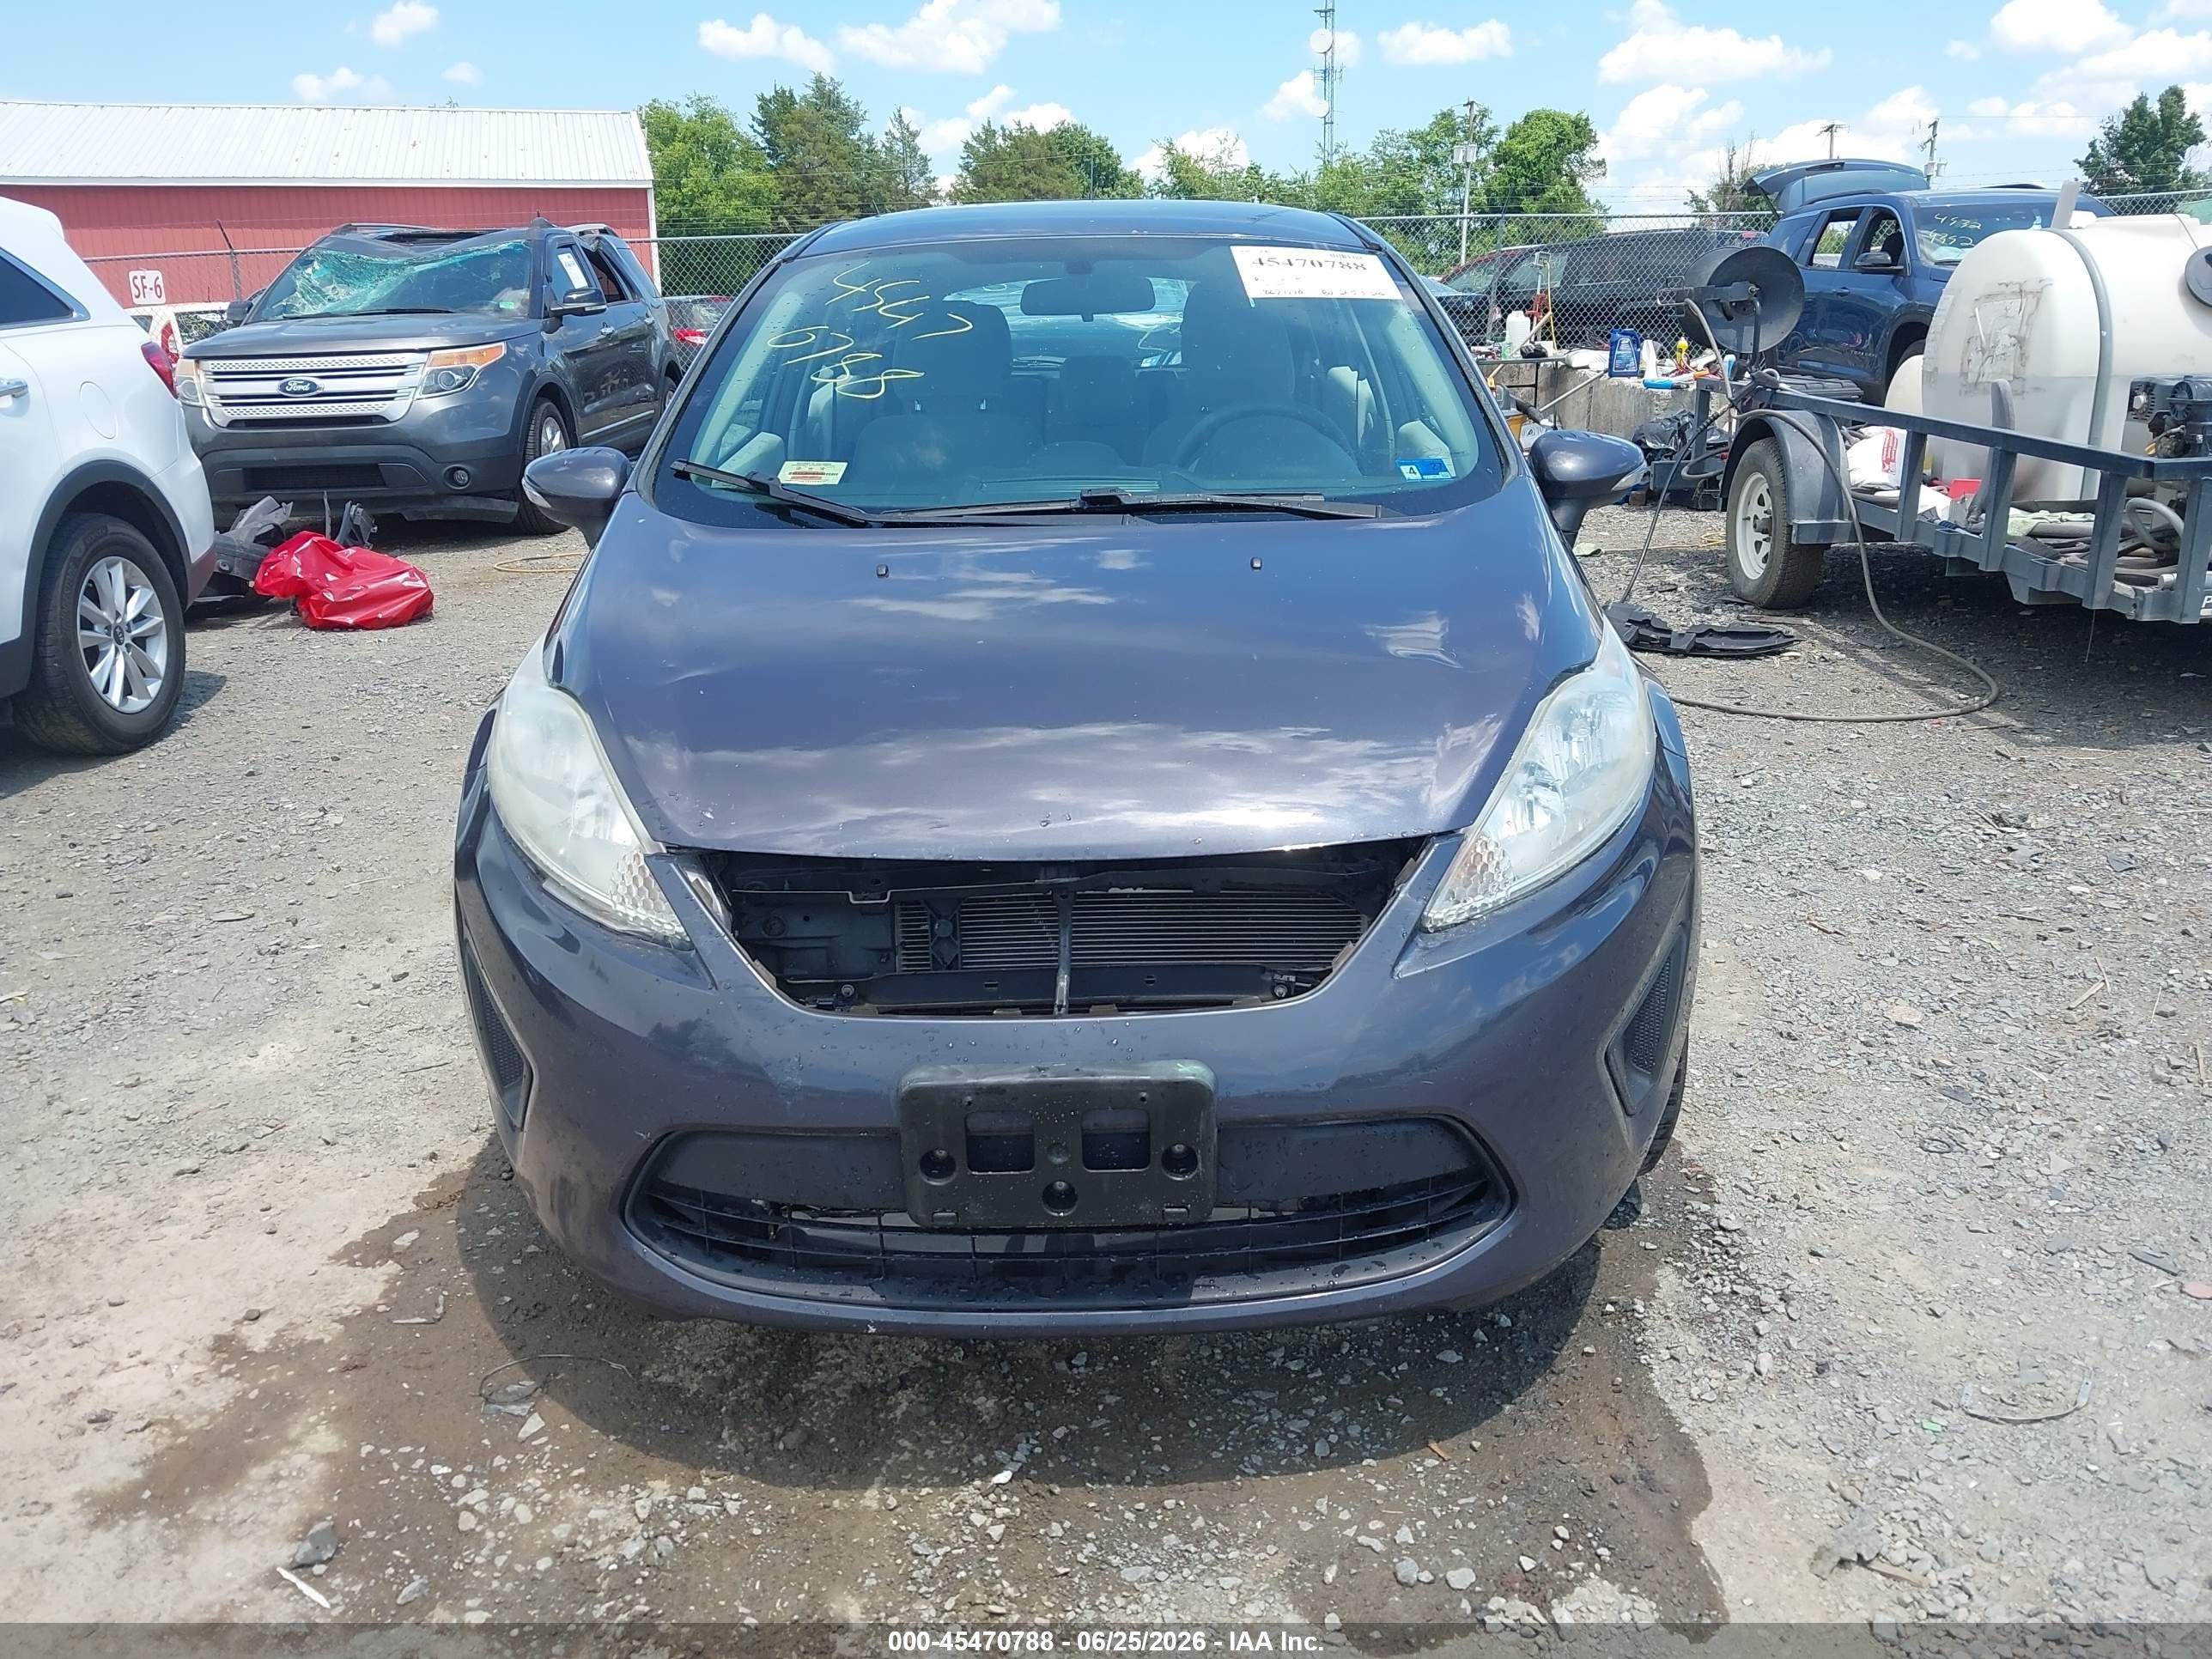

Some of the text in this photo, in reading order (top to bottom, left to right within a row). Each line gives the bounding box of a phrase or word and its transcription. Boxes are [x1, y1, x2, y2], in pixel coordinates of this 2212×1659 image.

[1252, 257, 1367, 270] 45470788
[132, 275, 162, 299] SF-6
[285, 380, 310, 392] Ford
[1408, 466, 1417, 475] 4
